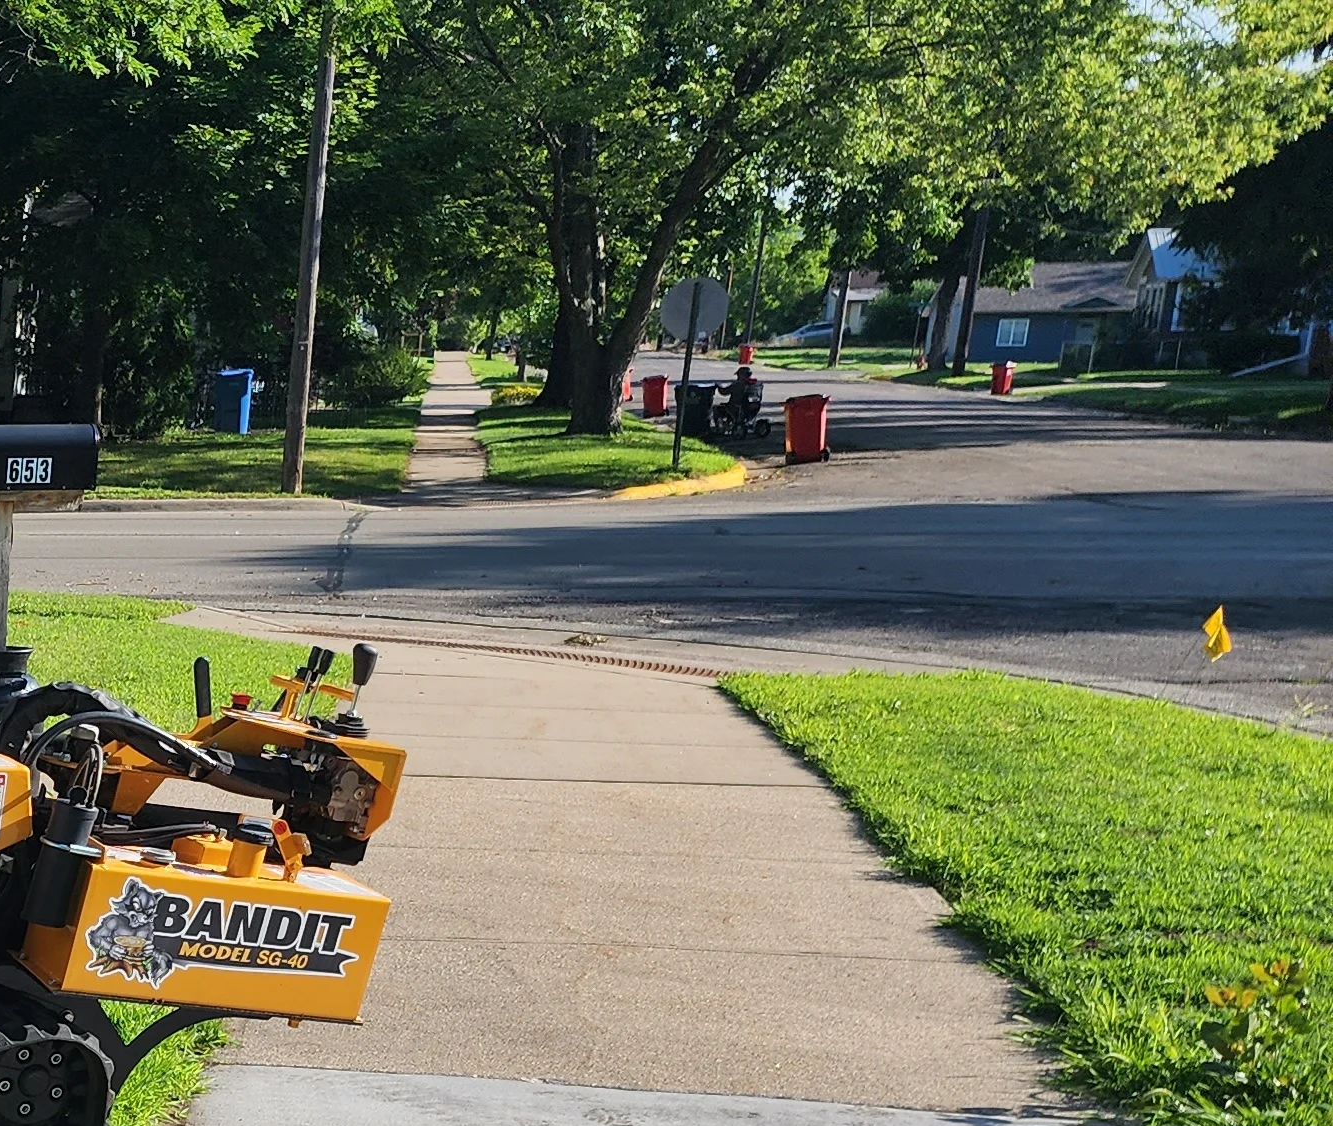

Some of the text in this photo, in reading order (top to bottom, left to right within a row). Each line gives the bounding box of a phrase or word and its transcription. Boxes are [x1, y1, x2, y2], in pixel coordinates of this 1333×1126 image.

[8, 458, 51, 483] 653
[153, 895, 353, 954] BANDIT
[179, 941, 309, 969] MODEL SG-40
